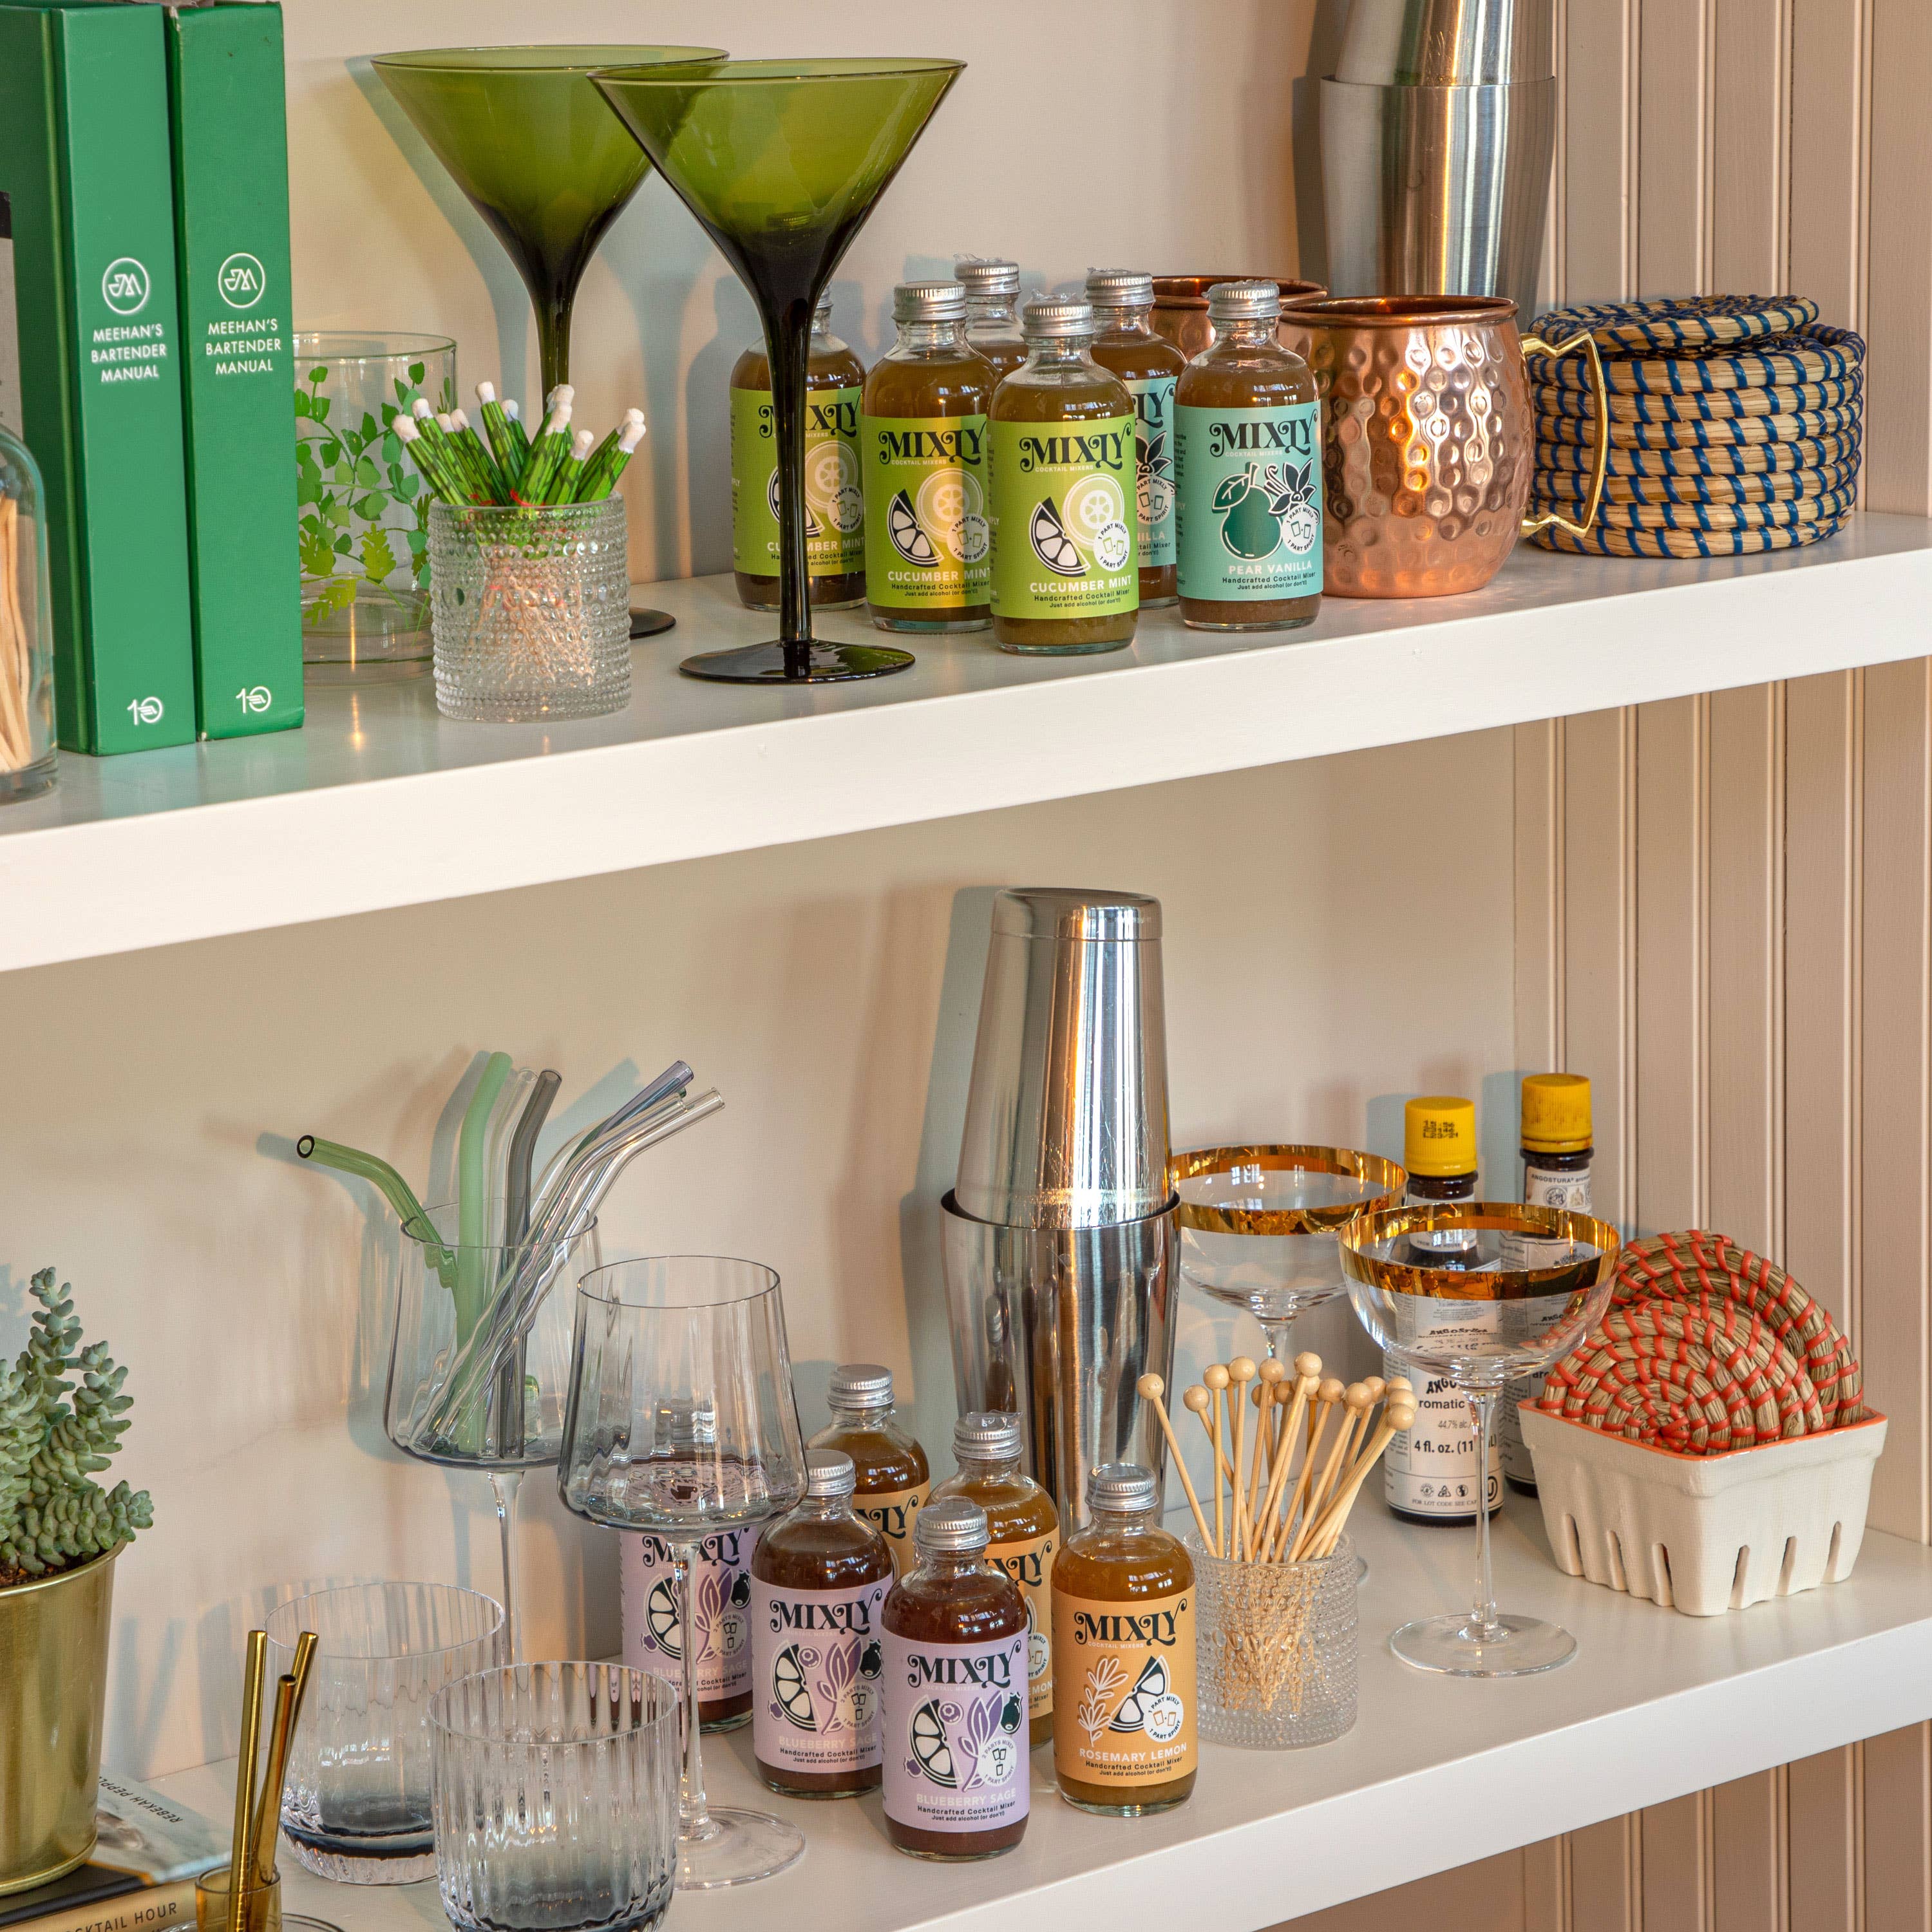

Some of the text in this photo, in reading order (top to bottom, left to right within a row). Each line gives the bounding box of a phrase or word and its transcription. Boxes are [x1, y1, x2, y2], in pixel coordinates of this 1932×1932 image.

[93, 323, 162, 343] MEEHAN'S
[208, 318, 278, 336] MEEHAN'S
[91, 343, 167, 363] BARTENDER
[205, 338, 281, 355] BARTENDER
[101, 364, 159, 383] MANUAL
[215, 359, 273, 375] MANUAL
[1209, 408, 1318, 457] MIXLY
[878, 421, 987, 464] MIXLY
[1019, 422, 1132, 473] MIXLY
[1137, 478, 1168, 489] PART MIXLY
[835, 488, 847, 499] PART
[1139, 513, 1153, 522] PART
[1155, 506, 1169, 521] SPIRIT
[1289, 507, 1314, 519] PART MIXLY
[837, 521, 849, 530] PART
[955, 517, 969, 528] PART
[971, 516, 986, 528] MIXLY
[1101, 523, 1126, 536] PART MIXLY
[767, 537, 865, 552] CMBER MINT
[957, 542, 987, 560] PART SPIRIT
[1290, 534, 1315, 552] PART SPIRIT
[1103, 550, 1128, 568] PART SPIRIT
[1229, 560, 1312, 574] PEAR VANILLA
[888, 571, 959, 582] CUCUMBER
[1030, 575, 1132, 593] CUCUMBER MINT
[1419, 1399, 1465, 1409] romatic
[1415, 1440, 1421, 1452] 4
[1423, 1440, 1435, 1453] fl.
[1437, 1444, 1454, 1454] oz.
[1457, 1440, 1473, 1455] (11
[642, 1527, 750, 1567] MLY
[770, 1588, 882, 1635] MIXLY
[1074, 1598, 1188, 1646] MIXLY
[1034, 1635, 1046, 1645] MIXLY
[907, 1640, 1021, 1689] MIXLY
[1036, 1658, 1047, 1676] SPIRIT
[654, 1667, 719, 1679] BLUERRY
[701, 1676, 730, 1685] Cocktail
[844, 1684, 860, 1699] PARTS
[1151, 1696, 1180, 1709] PART MIXLY
[1168, 1720, 1181, 1738] SPIRIT
[779, 1736, 844, 1749] BLUEBERRY
[985, 1739, 1014, 1754] PARTS MIXLY
[780, 1747, 824, 1757] Handcrafted
[860, 1745, 876, 1754] Mixer
[1079, 1743, 1187, 1762] ROSEMARY LEMON
[1086, 1757, 1183, 1770] Handcrafted Cocktail Mixer
[1001, 1765, 1014, 1783] SPIRIT
[99, 1776, 183, 1823] REBEKAH PEPPL
[916, 1788, 1016, 1807] BLUEBERRY SAGE
[918, 1801, 1016, 1815] Handcrafted Cocktail Mixer
[66, 1902, 176, 1932] KTAIL HOUR
